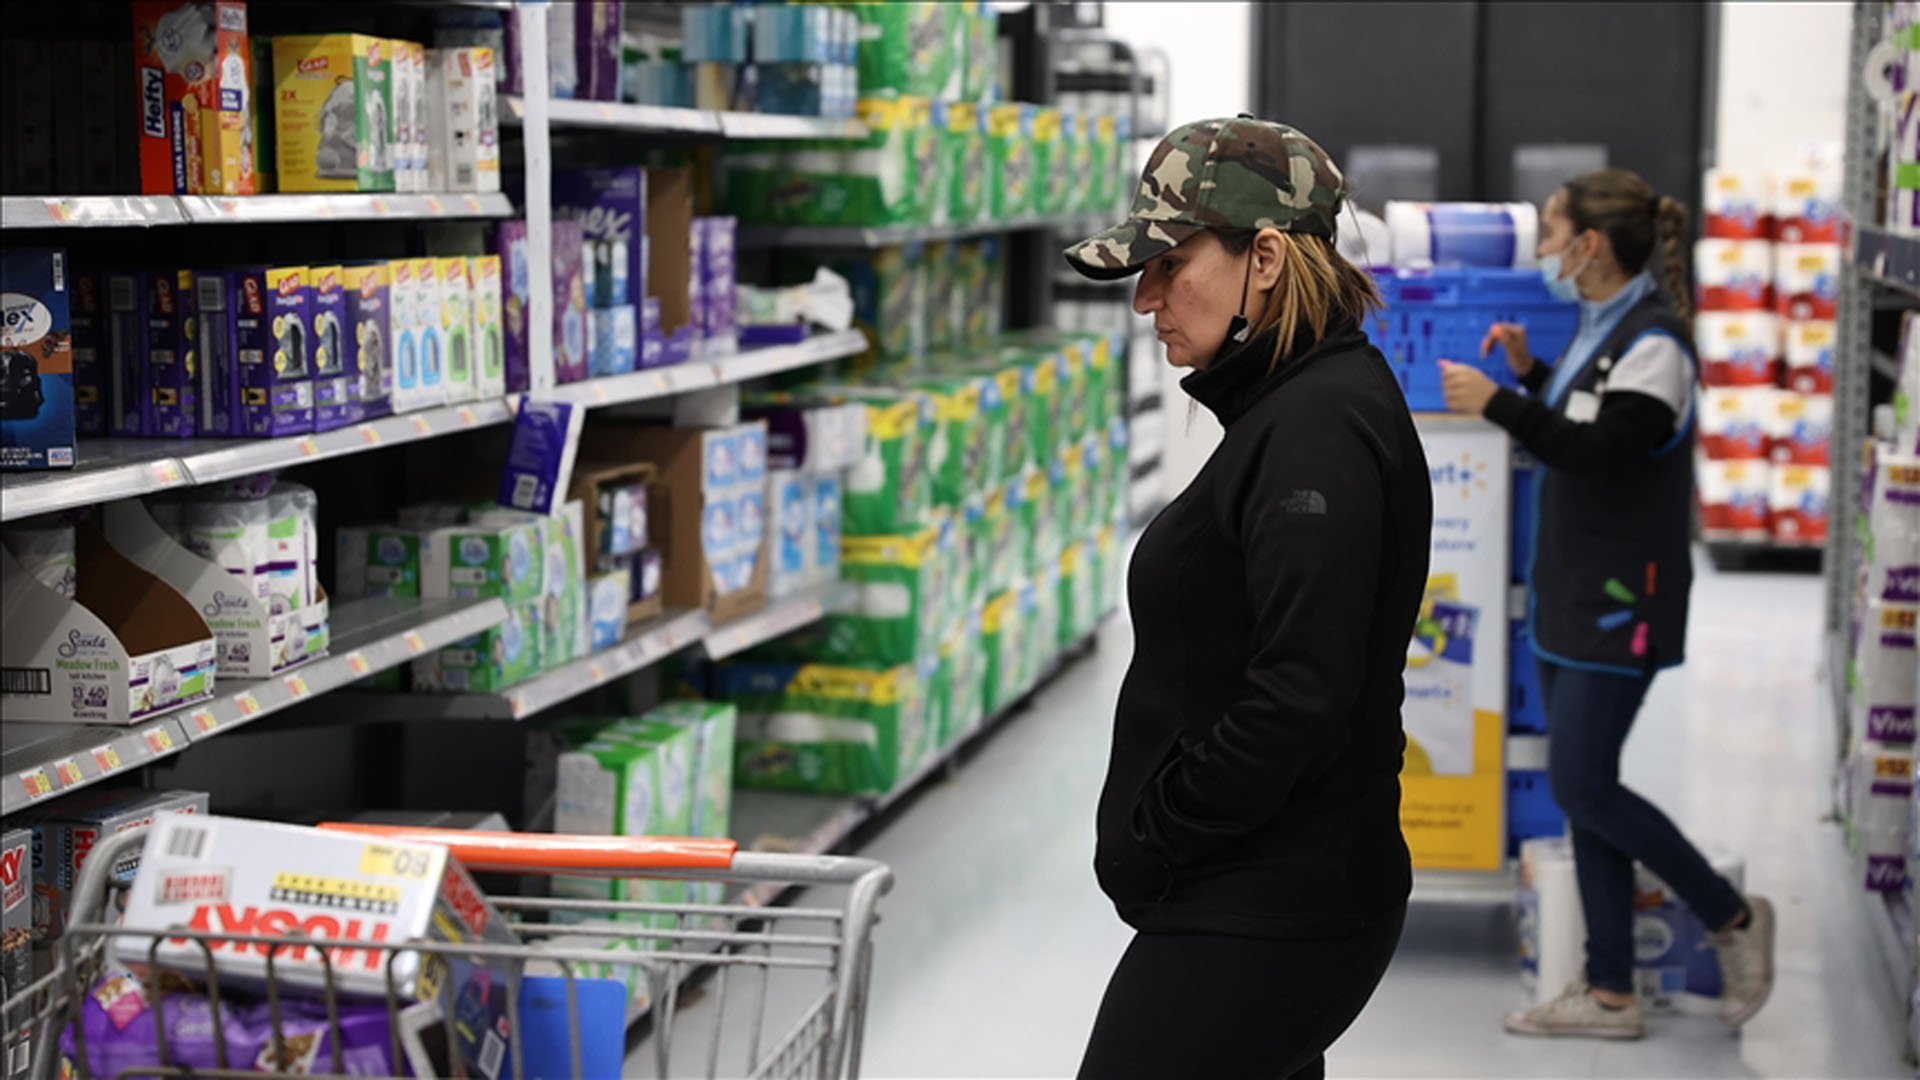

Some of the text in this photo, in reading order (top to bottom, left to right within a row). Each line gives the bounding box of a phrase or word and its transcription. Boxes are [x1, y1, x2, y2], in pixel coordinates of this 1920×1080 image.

[144, 70, 164, 133] Hefty
[281, 90, 296, 101] 2X
[175, 154, 185, 188] ULTRA
[57, 628, 106, 658] Scents
[56, 658, 119, 671] Meadow Fresh
[168, 902, 389, 970] HUSKY
